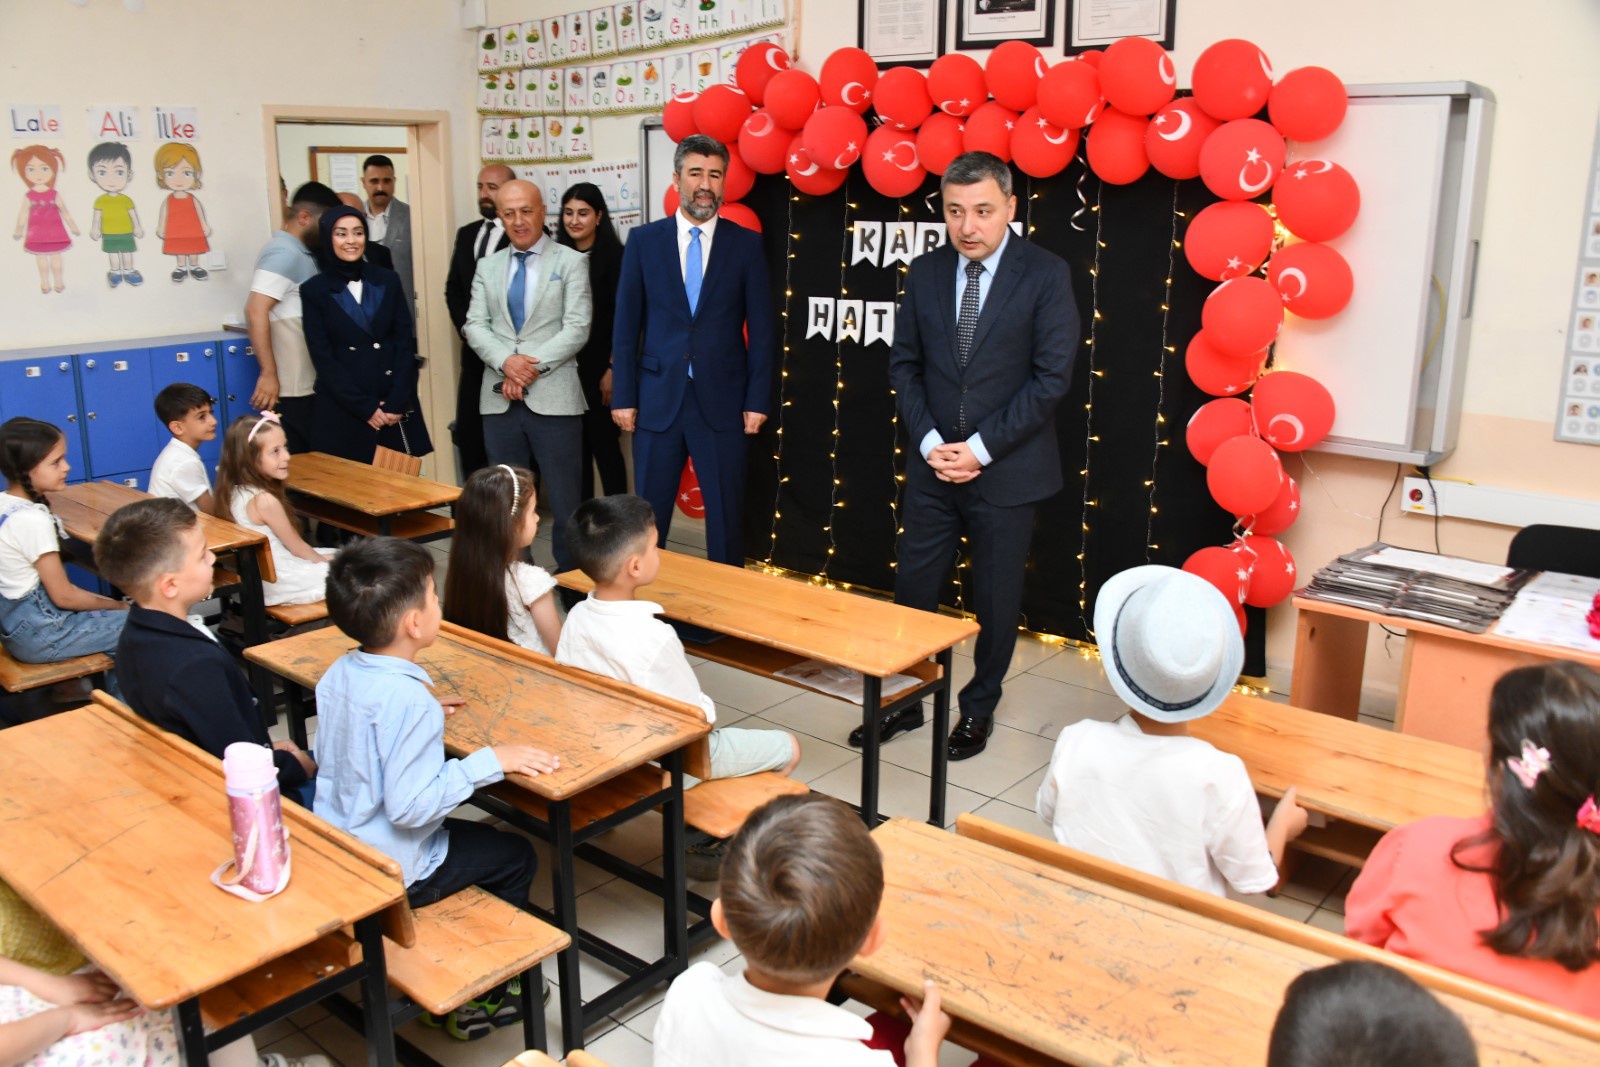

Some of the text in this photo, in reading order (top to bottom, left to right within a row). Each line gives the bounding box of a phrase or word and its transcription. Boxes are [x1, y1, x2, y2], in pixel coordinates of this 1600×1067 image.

[11, 109, 60, 132] Lale
[99, 111, 134, 137] Ali
[549, 187, 558, 204] 3
[620, 182, 630, 200] 6
[859, 228, 940, 255] KAR
[813, 303, 888, 333] HAT
